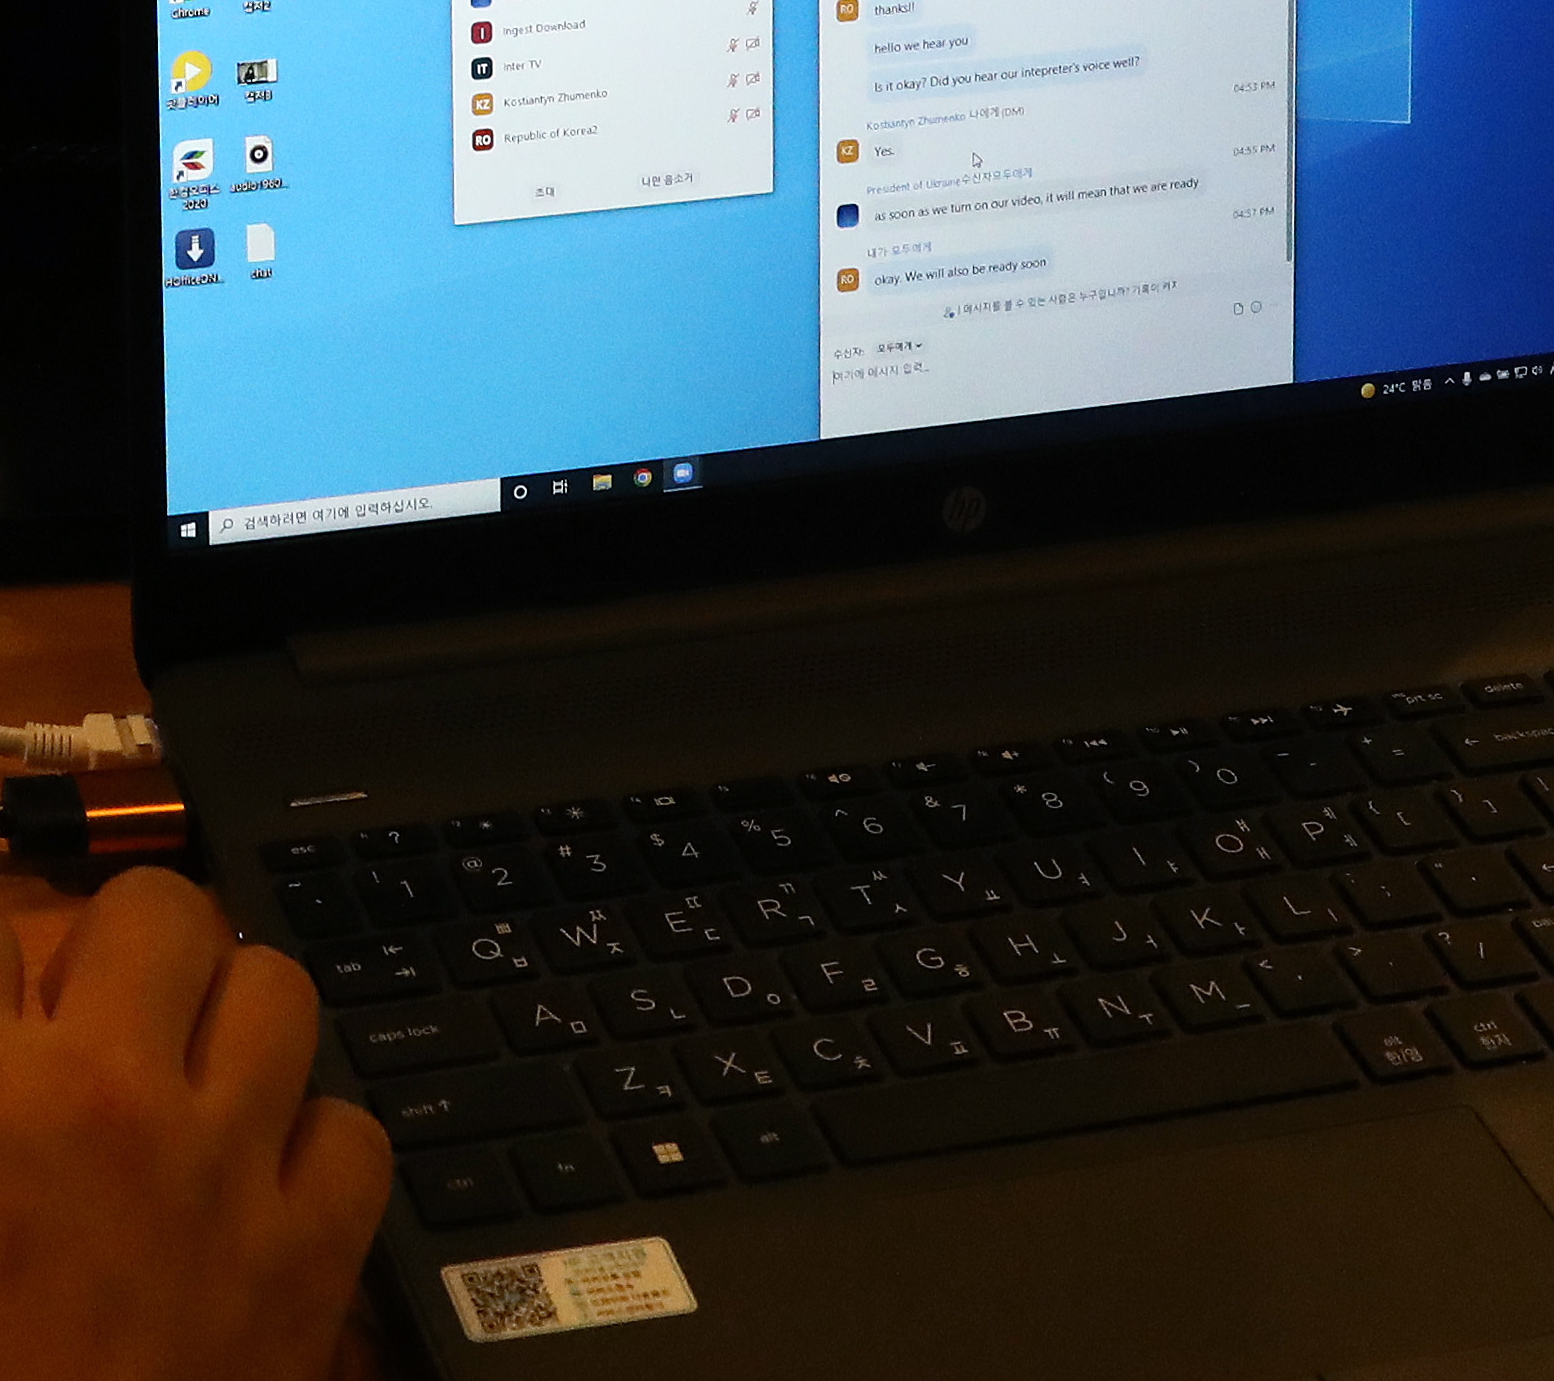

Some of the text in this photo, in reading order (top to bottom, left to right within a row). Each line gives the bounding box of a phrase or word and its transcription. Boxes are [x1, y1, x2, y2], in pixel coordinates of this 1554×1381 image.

[170, 6, 210, 18] Chrome
[503, 20, 586, 37] Ingest Download
[874, 36, 969, 55] hello we hear you
[477, 63, 488, 74] IT
[503, 60, 542, 72] Inter TV
[874, 82, 883, 93] Is
[885, 81, 894, 92] it
[896, 76, 927, 91] okay?
[930, 73, 949, 87] Did
[952, 74, 971, 88] you
[975, 70, 998, 83] hear
[1001, 69, 1018, 80] our
[1083, 59, 1110, 72] voice
[1113, 55, 1140, 69] well?
[476, 99, 490, 110] KZ
[504, 89, 608, 108] Kostiantyn Zhumenko
[475, 135, 491, 146] RO
[504, 125, 598, 144] Republic of Korea2
[874, 145, 895, 158] Yes.
[874, 211, 886, 221] as
[889, 208, 915, 220] soon
[918, 206, 930, 217] as
[932, 205, 948, 216] we
[950, 202, 972, 214] turn
[974, 201, 988, 212] on
[991, 199, 1009, 210] our
[1045, 193, 1054, 204] it
[1056, 190, 1075, 203] will
[1078, 188, 1106, 200] mean
[1109, 185, 1131, 197] that
[1133, 184, 1148, 194] we
[1151, 182, 1168, 192] are
[1170, 177, 1199, 192] ready
[874, 258, 1047, 288] okay. We will also be ready soon
[244, 511, 307, 530] 검색하려면
[312, 506, 350, 522] 여기에
